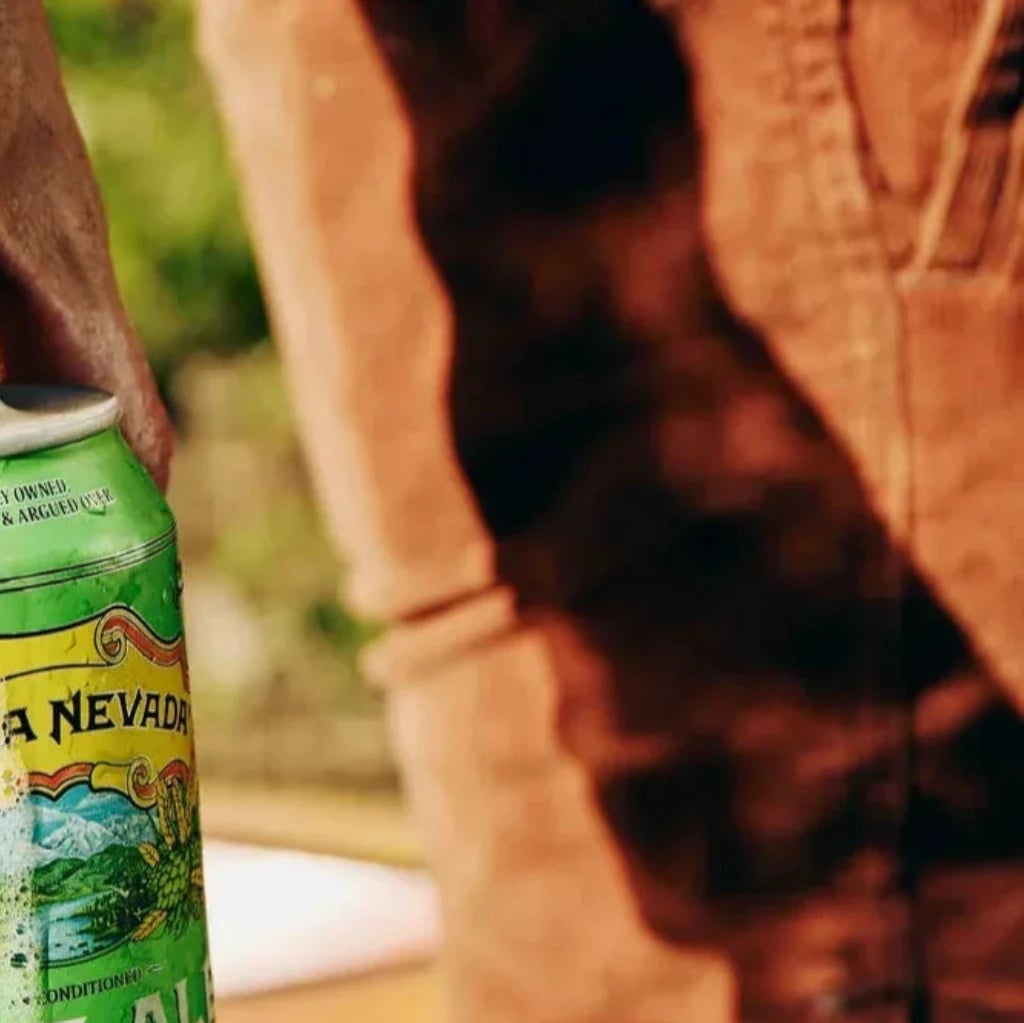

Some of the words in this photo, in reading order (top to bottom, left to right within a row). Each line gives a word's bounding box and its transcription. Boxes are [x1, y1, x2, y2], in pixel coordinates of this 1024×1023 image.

[2, 511, 14, 527] &
[18, 499, 78, 523] ARGUED
[49, 688, 188, 745] NEVADA
